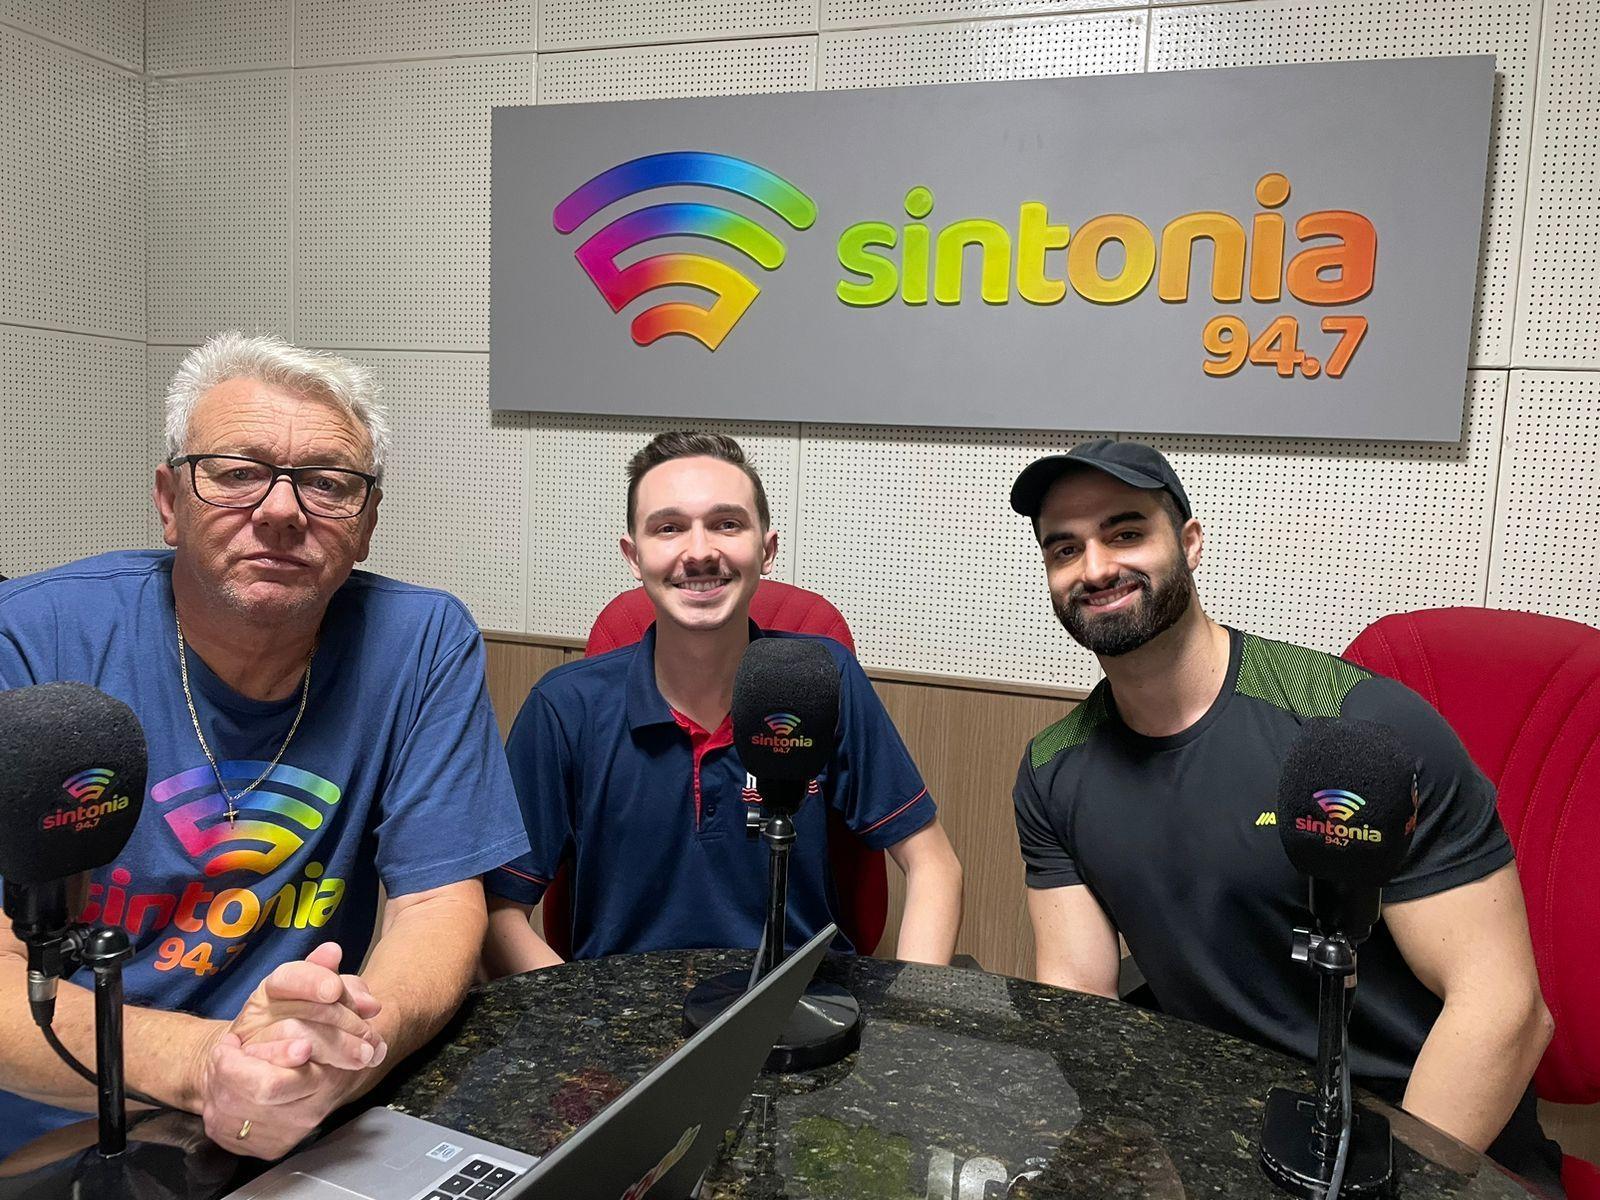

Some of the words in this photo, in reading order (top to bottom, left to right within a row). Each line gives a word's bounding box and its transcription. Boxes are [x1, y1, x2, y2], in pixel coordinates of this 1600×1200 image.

[836, 172, 1378, 306] sintonia
[1202, 315, 1369, 379] 94.7
[751, 733, 813, 747] sintonia
[43, 794, 129, 829] sintonia
[75, 818, 101, 832] 94.7
[1295, 815, 1382, 842] sintonia
[1324, 835, 1350, 847] 94.7
